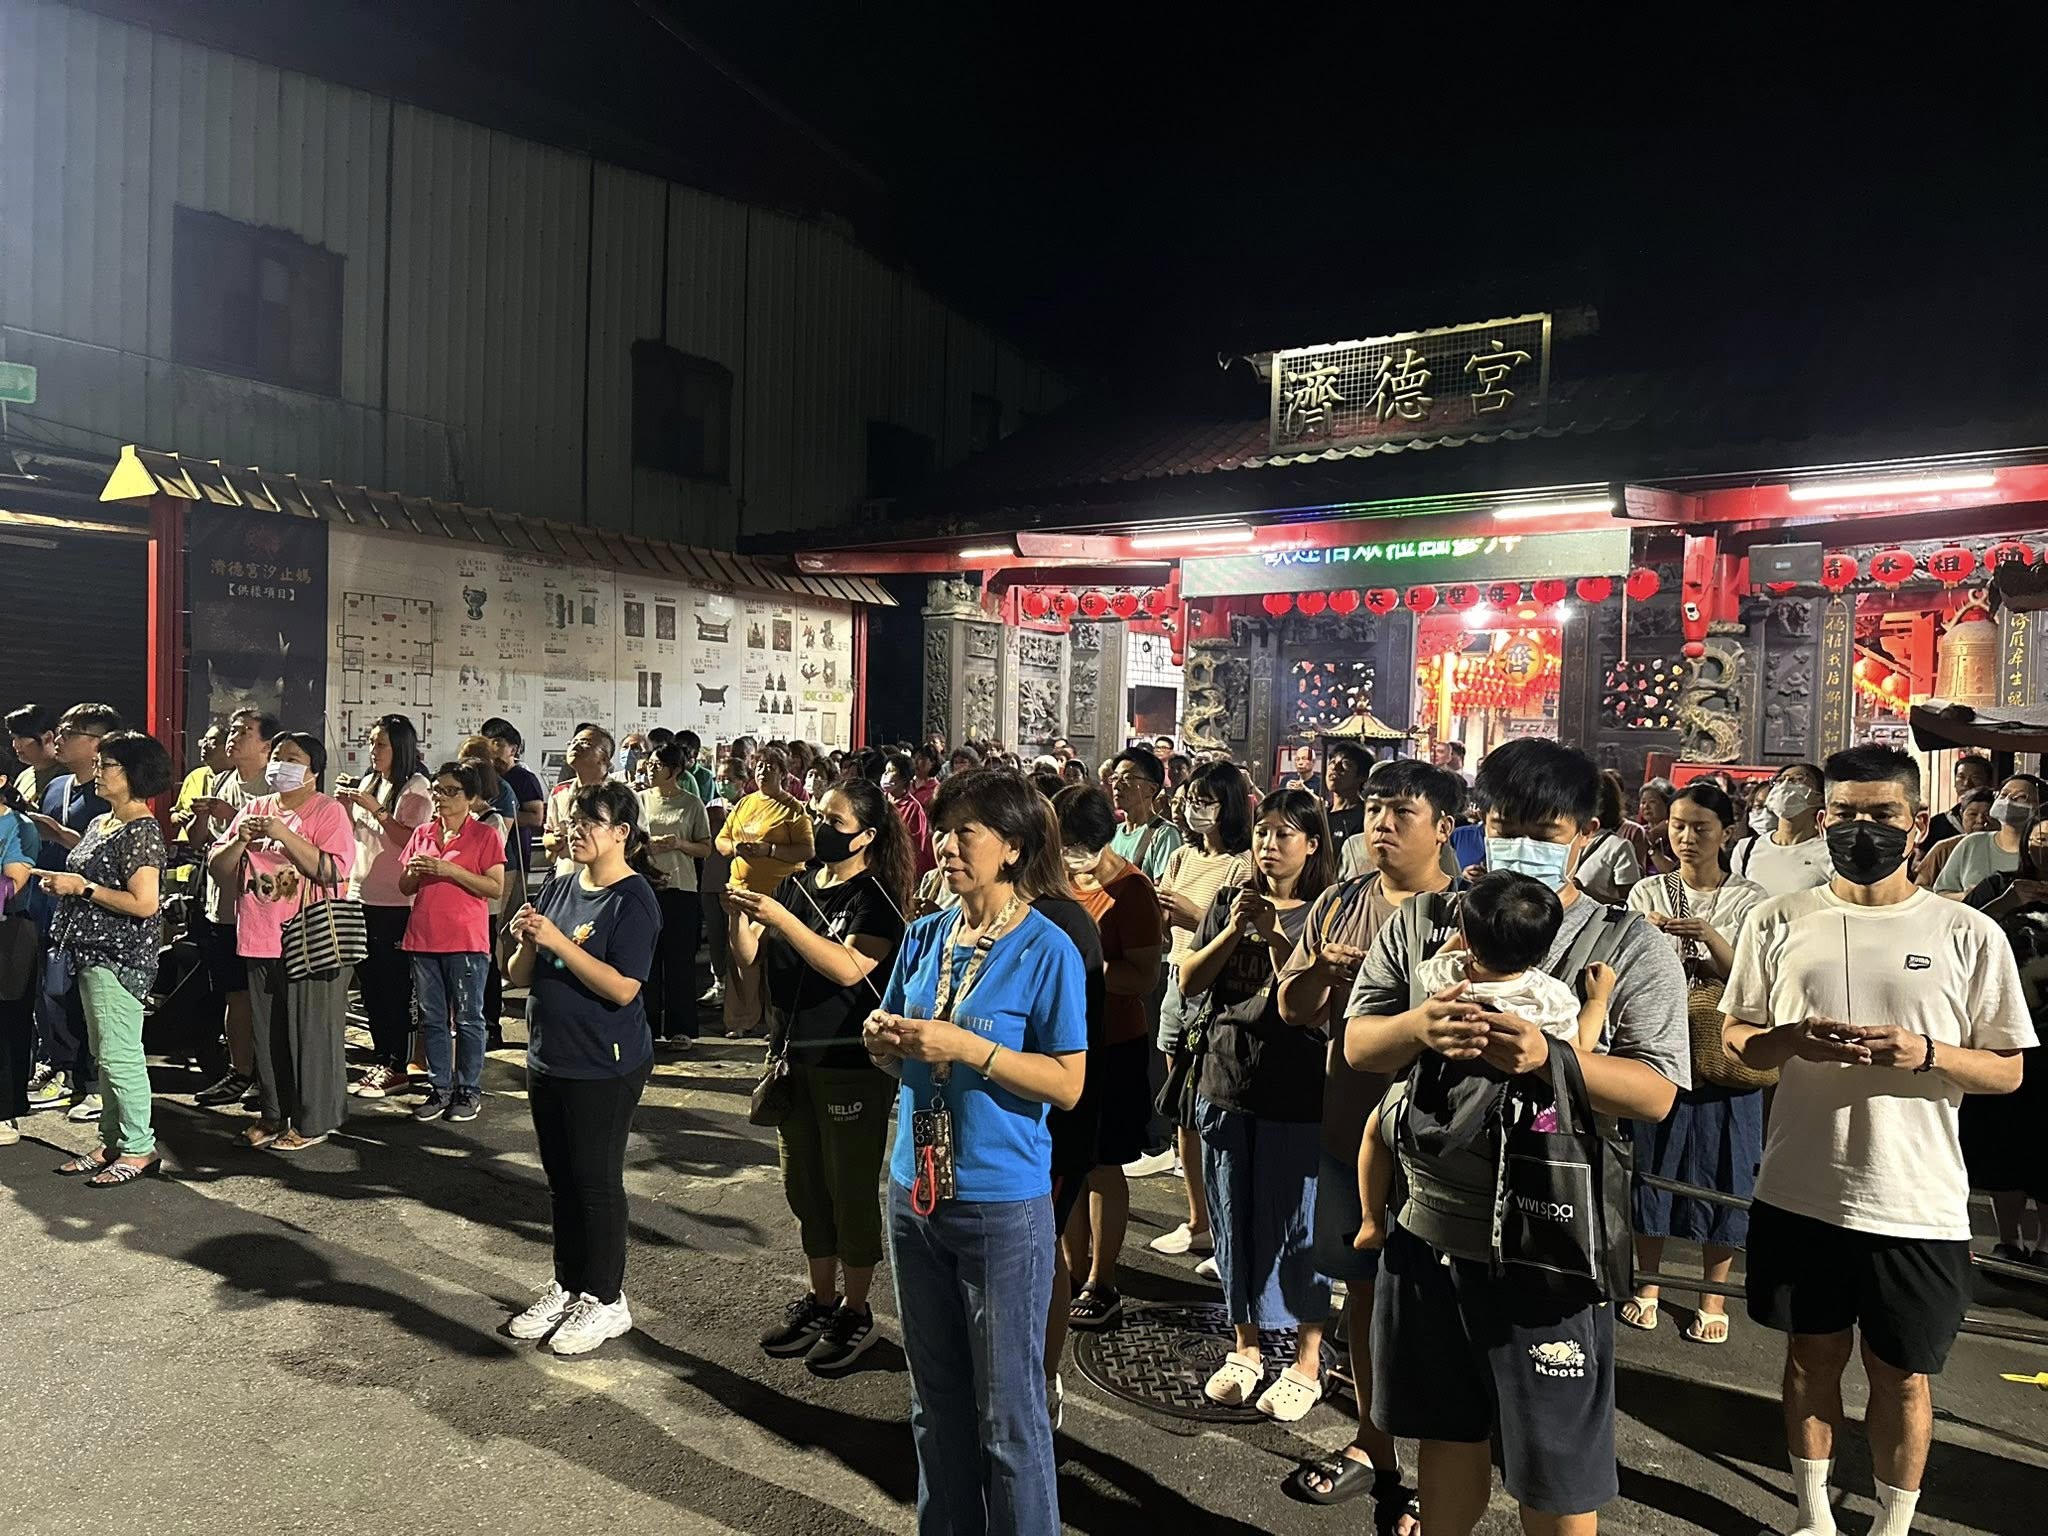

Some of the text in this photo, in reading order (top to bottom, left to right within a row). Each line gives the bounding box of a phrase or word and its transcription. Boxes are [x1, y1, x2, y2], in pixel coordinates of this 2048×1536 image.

[1283, 339, 1532, 438] 濟德宮
[827, 1102, 863, 1115] HELLO
[1535, 1362, 1584, 1377] Roots
